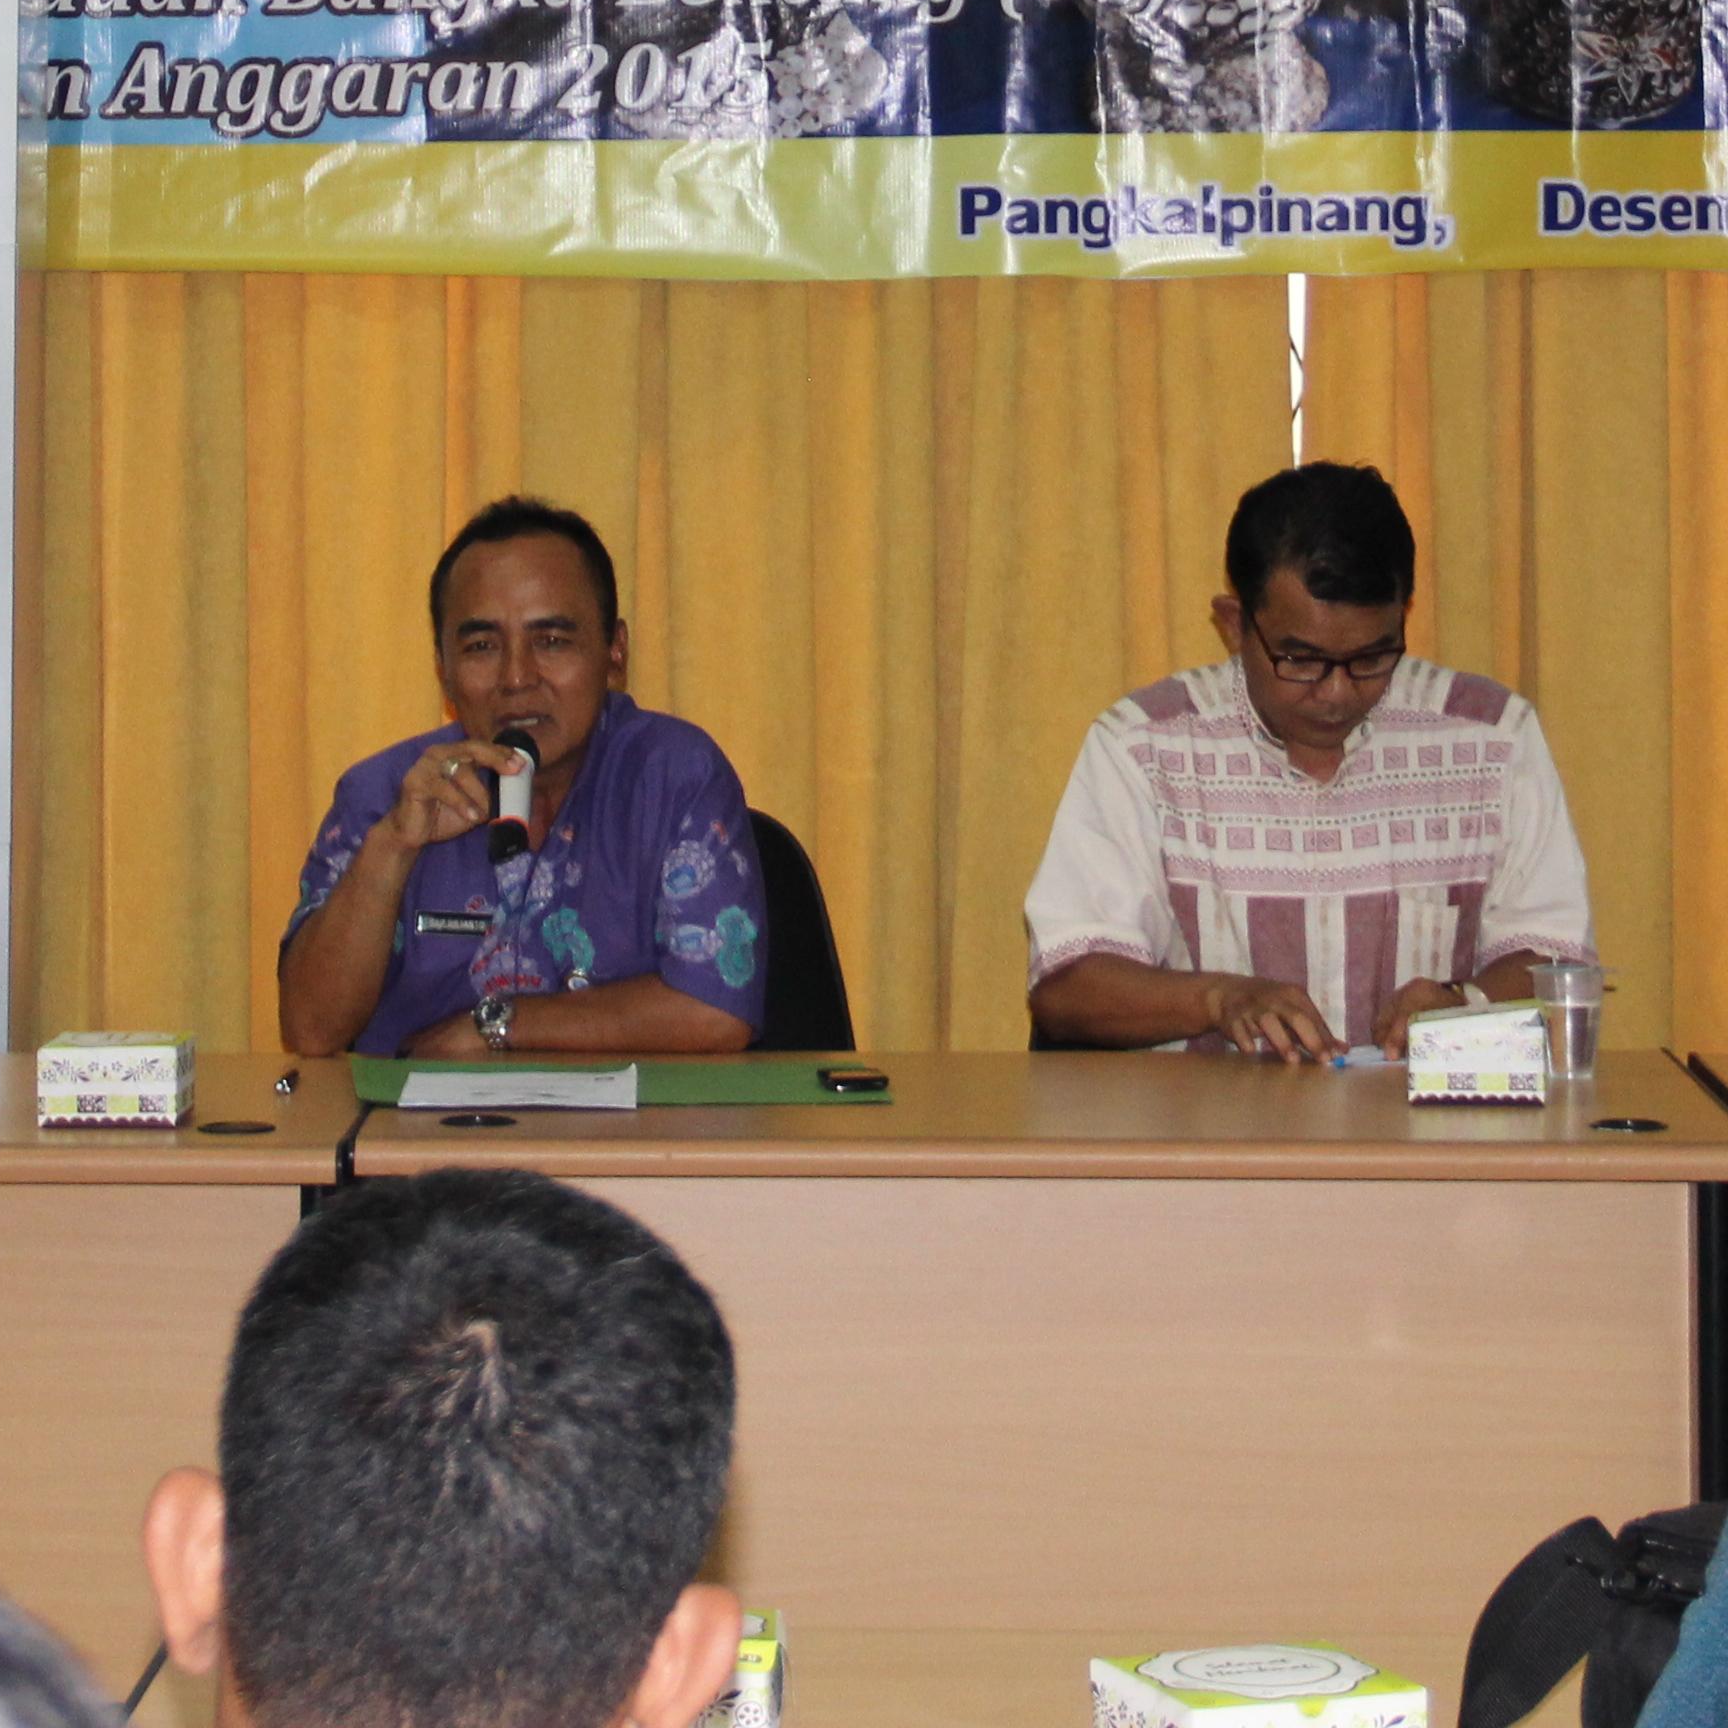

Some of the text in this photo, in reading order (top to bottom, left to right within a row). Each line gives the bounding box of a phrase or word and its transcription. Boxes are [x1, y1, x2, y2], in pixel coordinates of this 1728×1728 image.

[102, 46, 532, 135] Anggaran
[555, 41, 774, 114] 2015
[958, 184, 1449, 250] Pangkalpinang,
